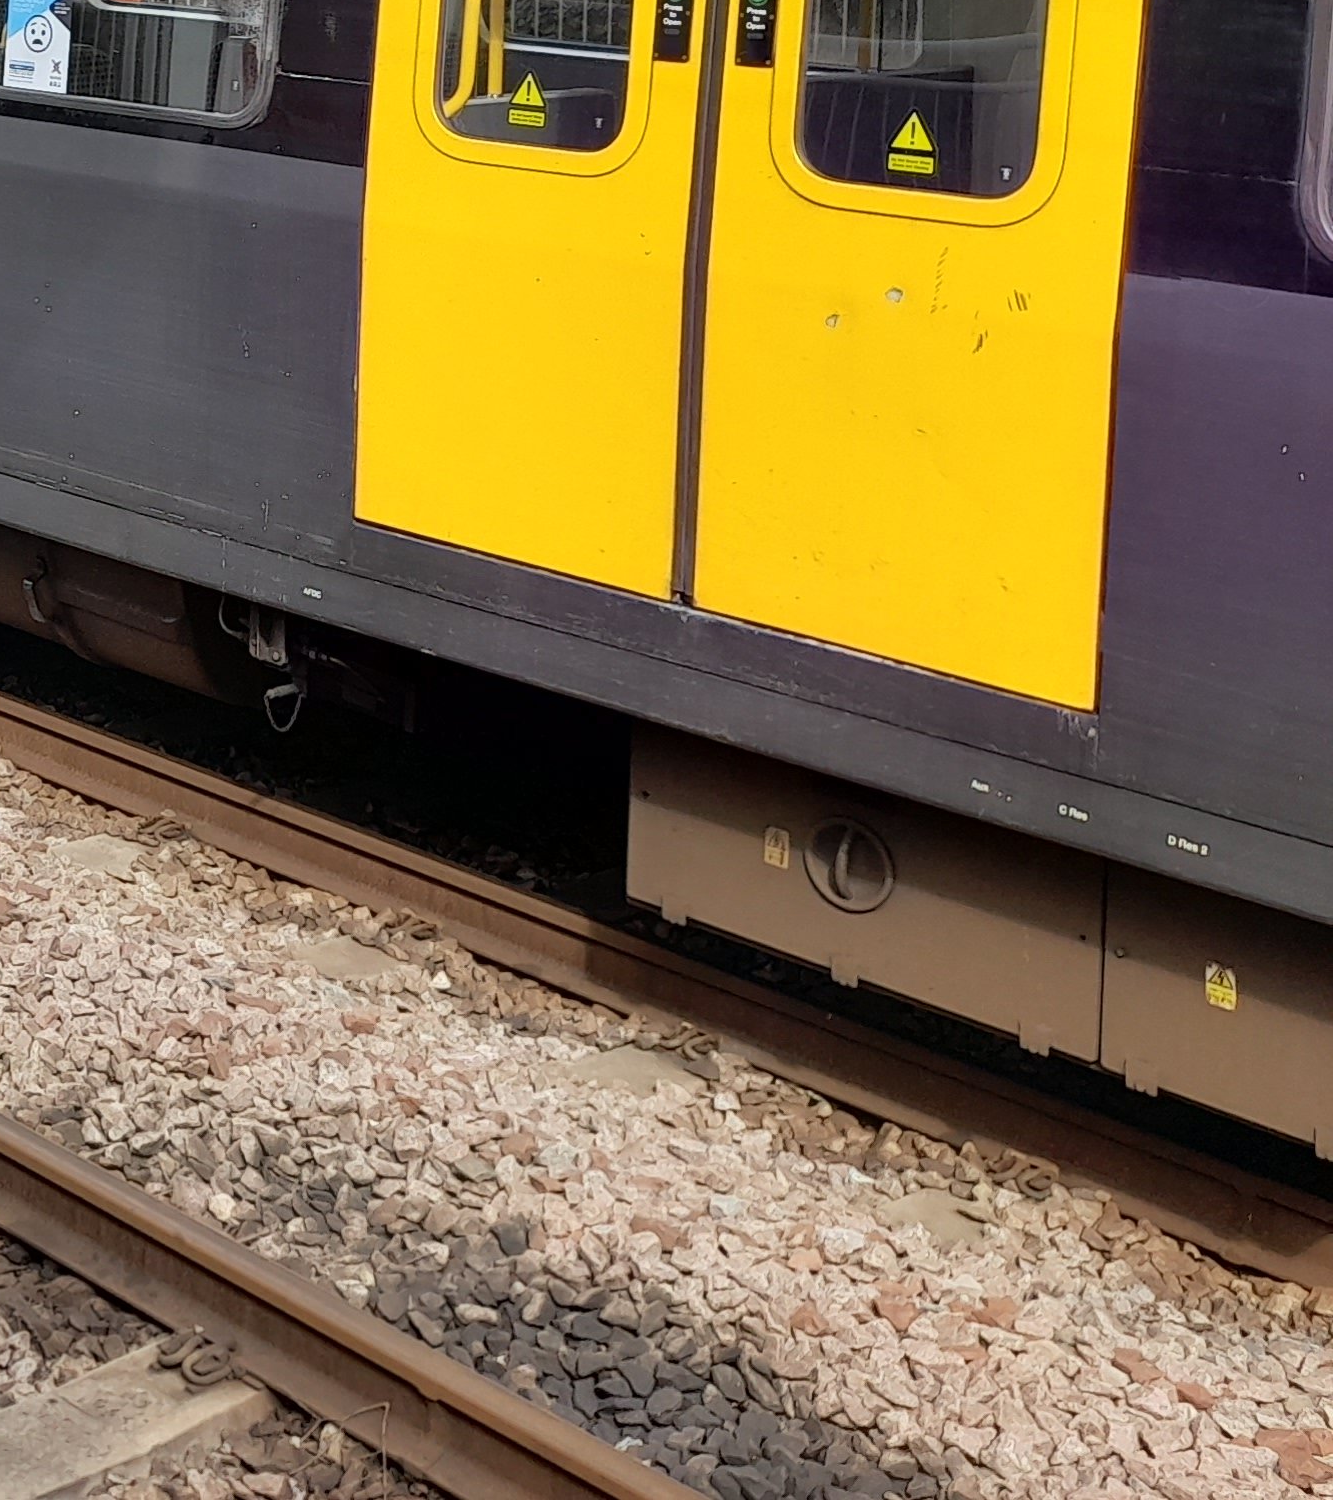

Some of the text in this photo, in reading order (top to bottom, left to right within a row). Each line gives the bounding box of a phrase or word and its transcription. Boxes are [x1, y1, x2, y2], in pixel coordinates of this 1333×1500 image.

[663, 3, 683, 12] Press
[746, 6, 767, 16] Press
[662, 17, 682, 26] Open
[745, 21, 766, 30] Open
[1177, 837, 1199, 853] Res
